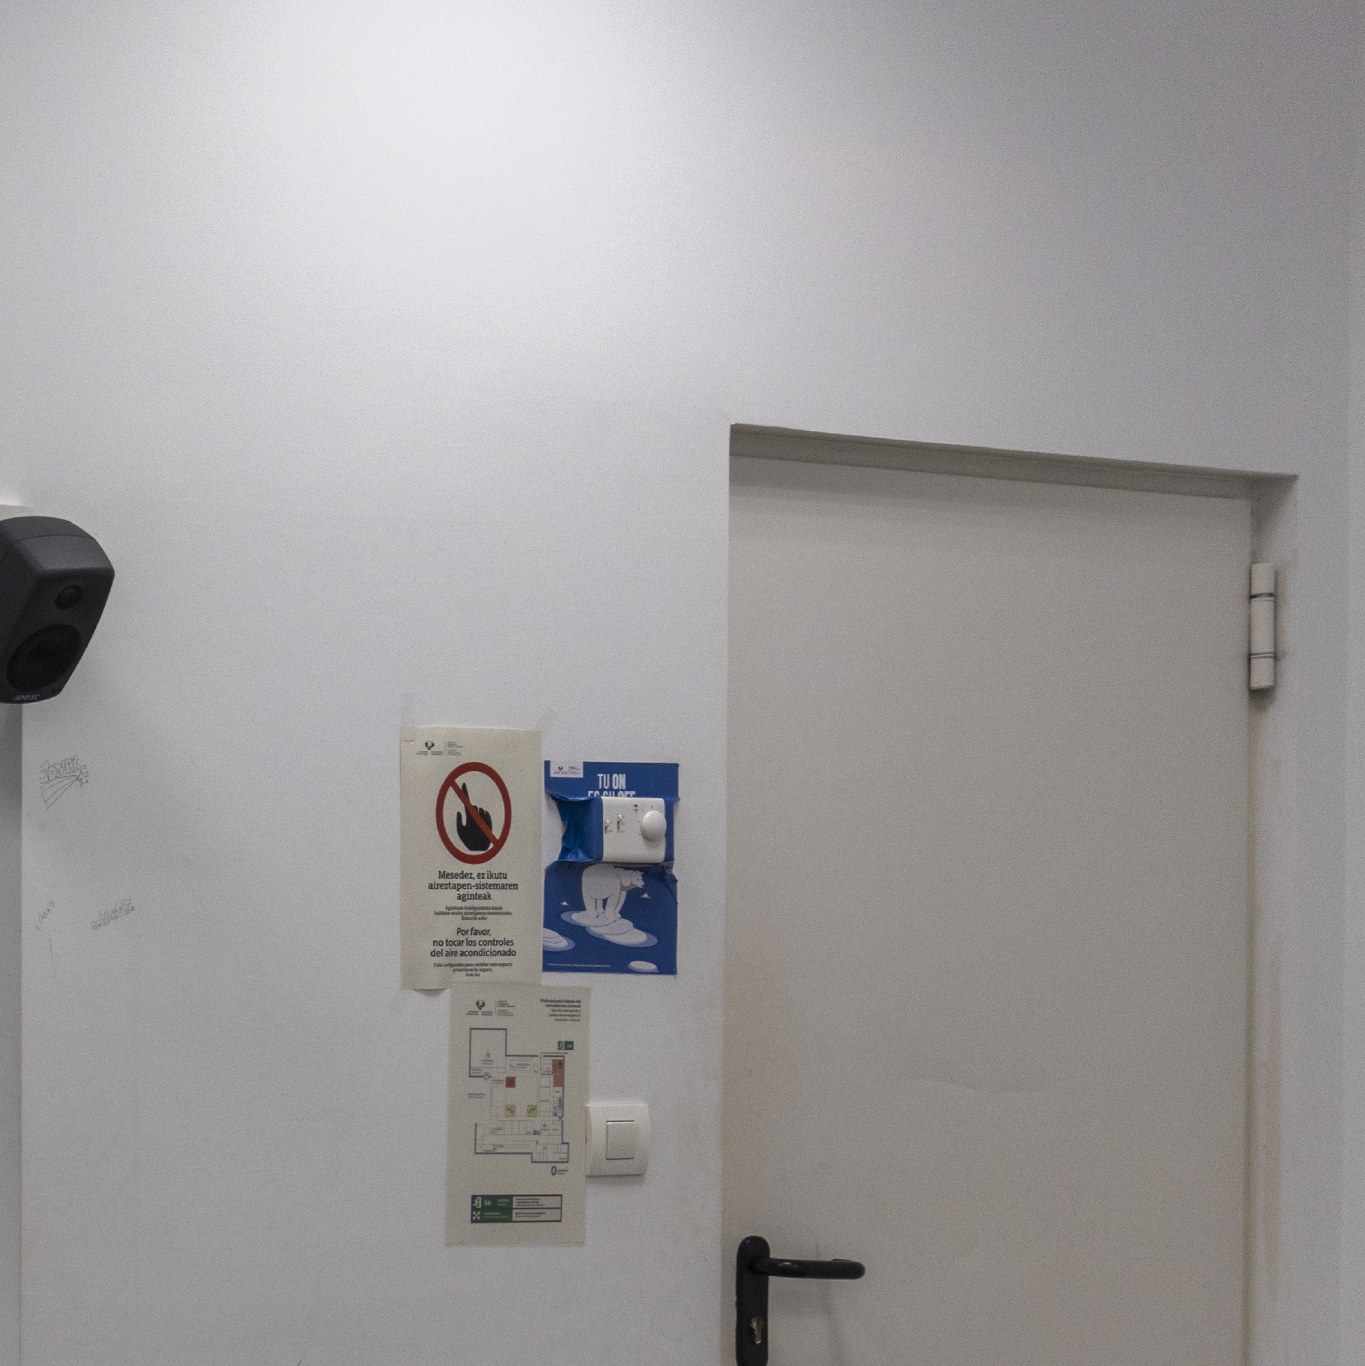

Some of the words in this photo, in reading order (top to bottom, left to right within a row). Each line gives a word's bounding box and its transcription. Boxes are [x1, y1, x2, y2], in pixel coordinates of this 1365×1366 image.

[597, 773, 609, 789] TU
[612, 773, 626, 790] ON
[438, 870, 475, 880] Mesedez,
[476, 872, 485, 880] ez
[486, 870, 508, 880] ikutu
[428, 881, 519, 891] aireztapen-sistemaren
[456, 892, 492, 902] aginteak
[456, 927, 469, 936] Por
[470, 927, 491, 936] favor,
[445, 938, 465, 947] tocar
[466, 938, 476, 946] los
[478, 938, 514, 947] controles
[430, 948, 443, 957] del
[444, 949, 458, 957] aire
[459, 948, 517, 957] acondicionado
